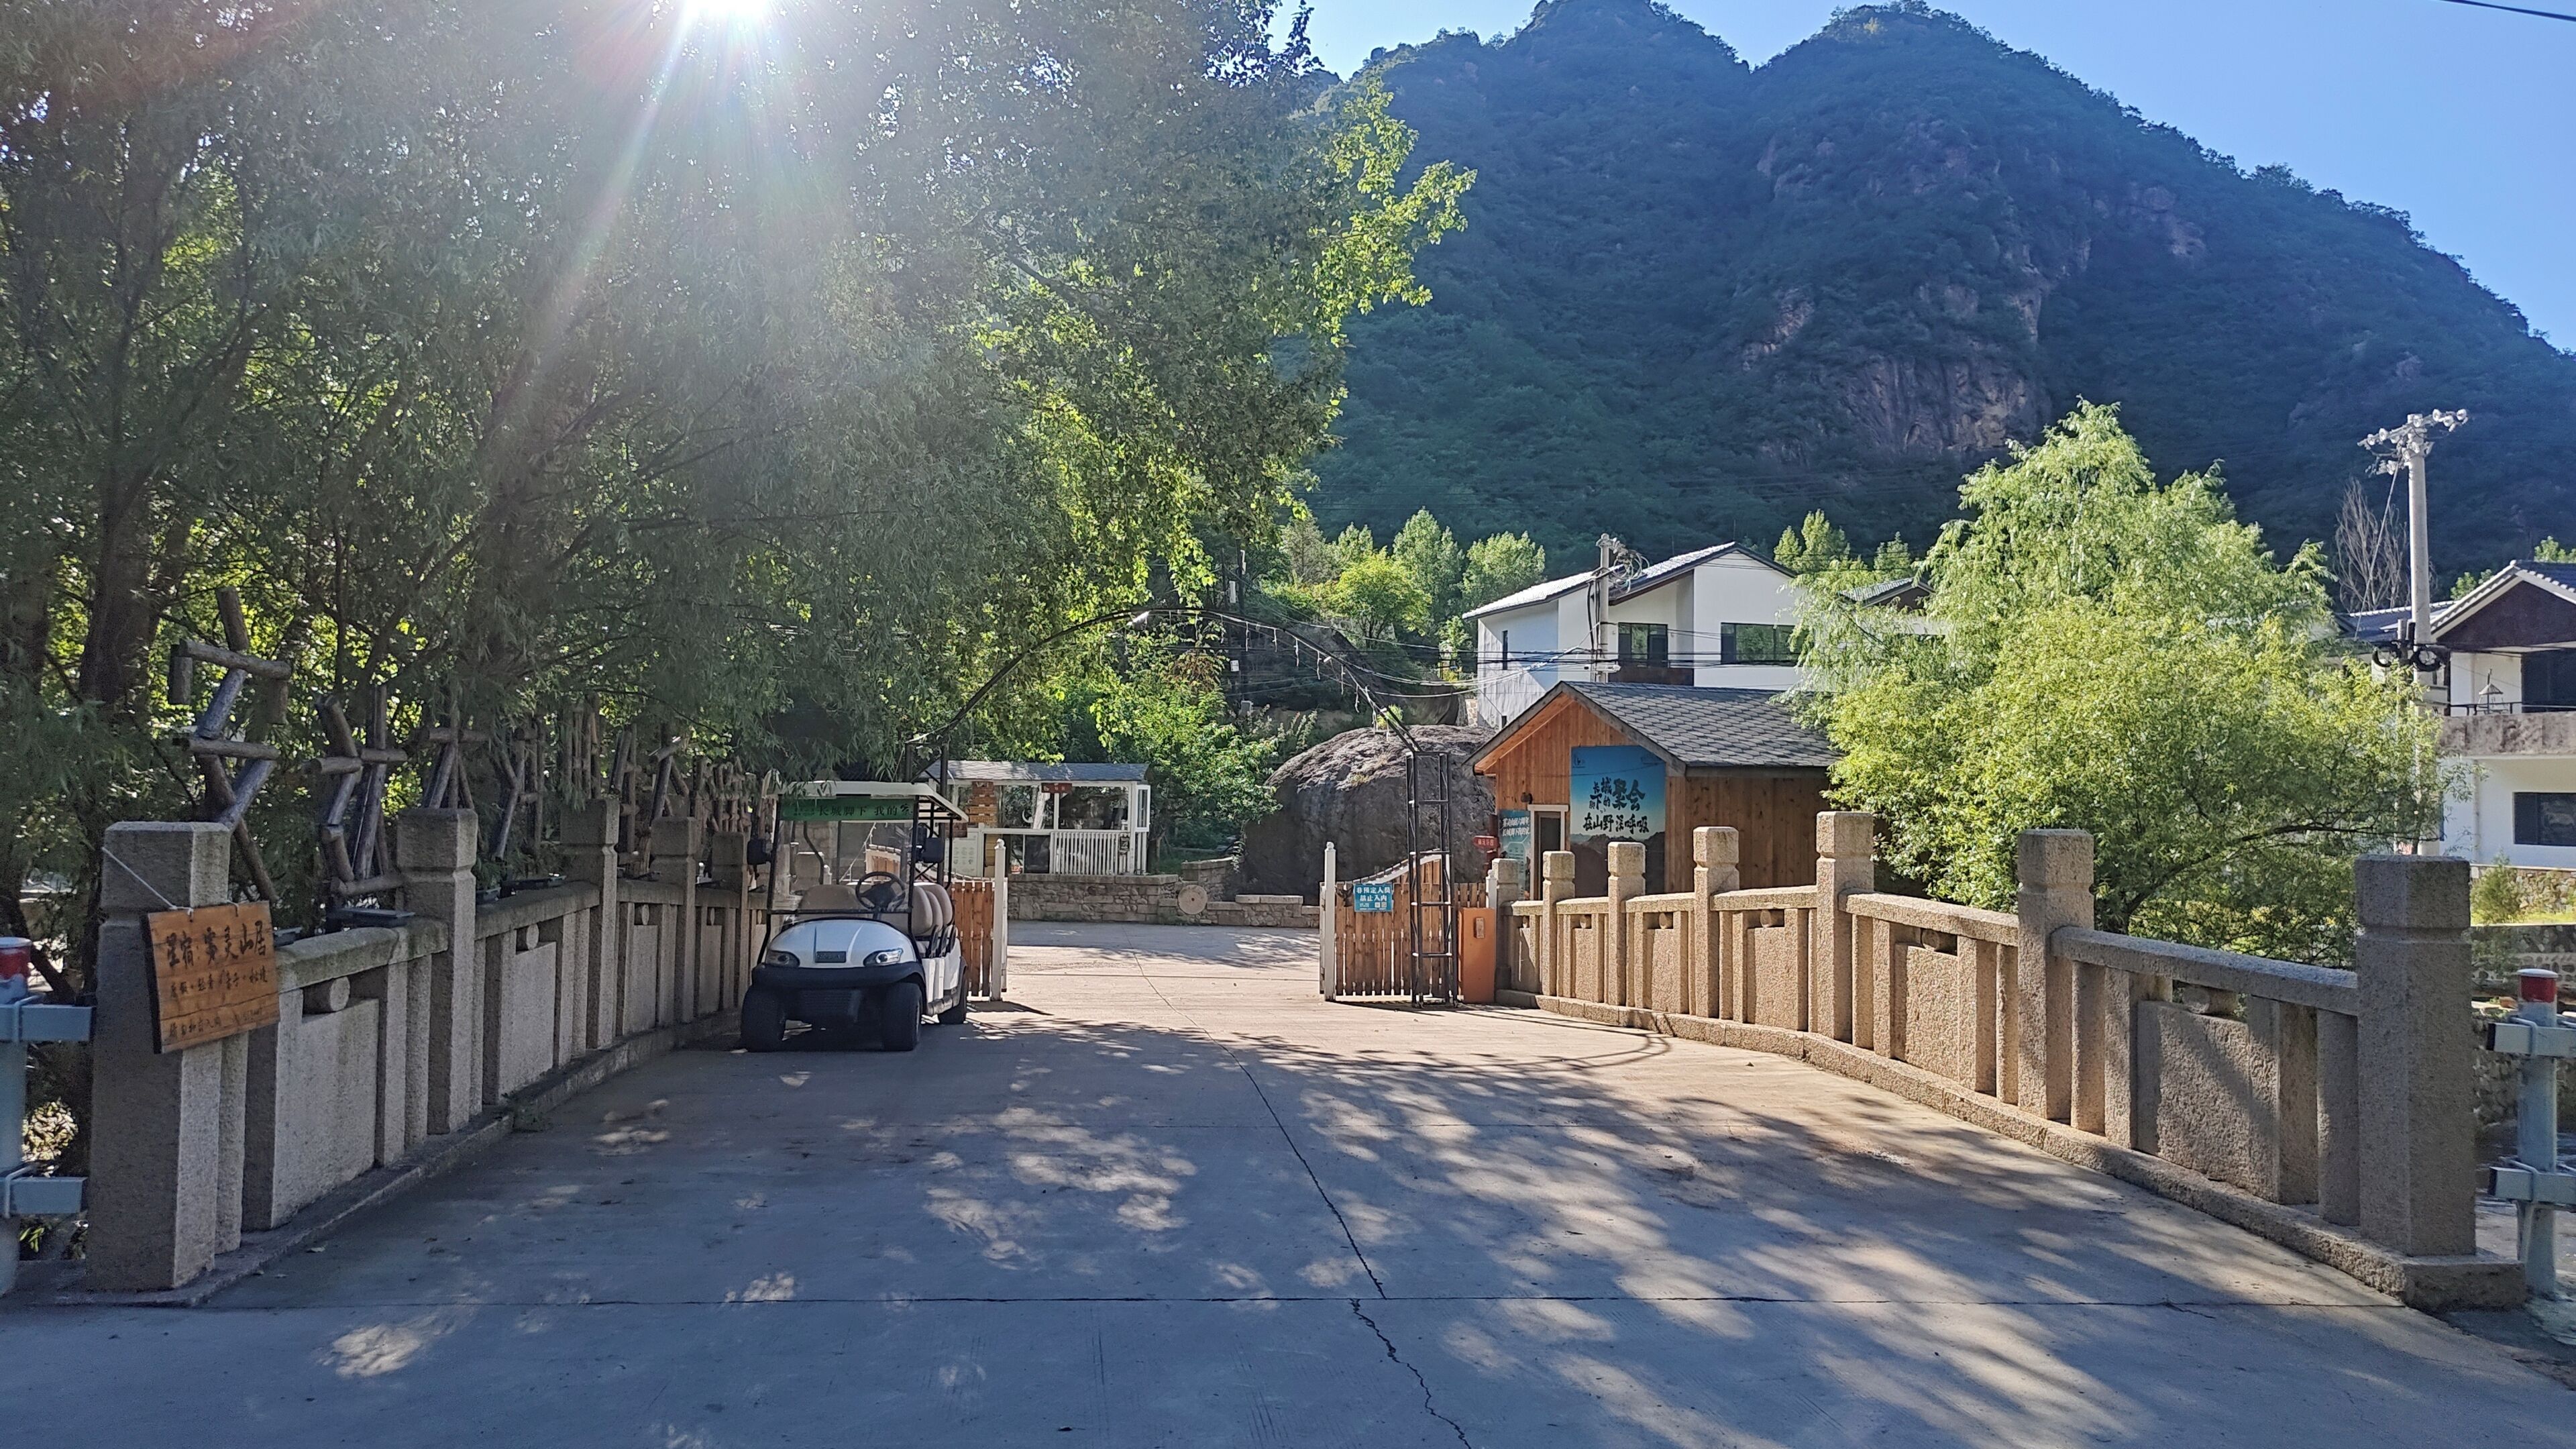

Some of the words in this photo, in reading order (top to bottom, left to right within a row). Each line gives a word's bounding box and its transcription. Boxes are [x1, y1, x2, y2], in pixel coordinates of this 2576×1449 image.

[818, 806, 867, 816] 长城脚下
[1582, 812, 1650, 835] 在山野深呼吸
